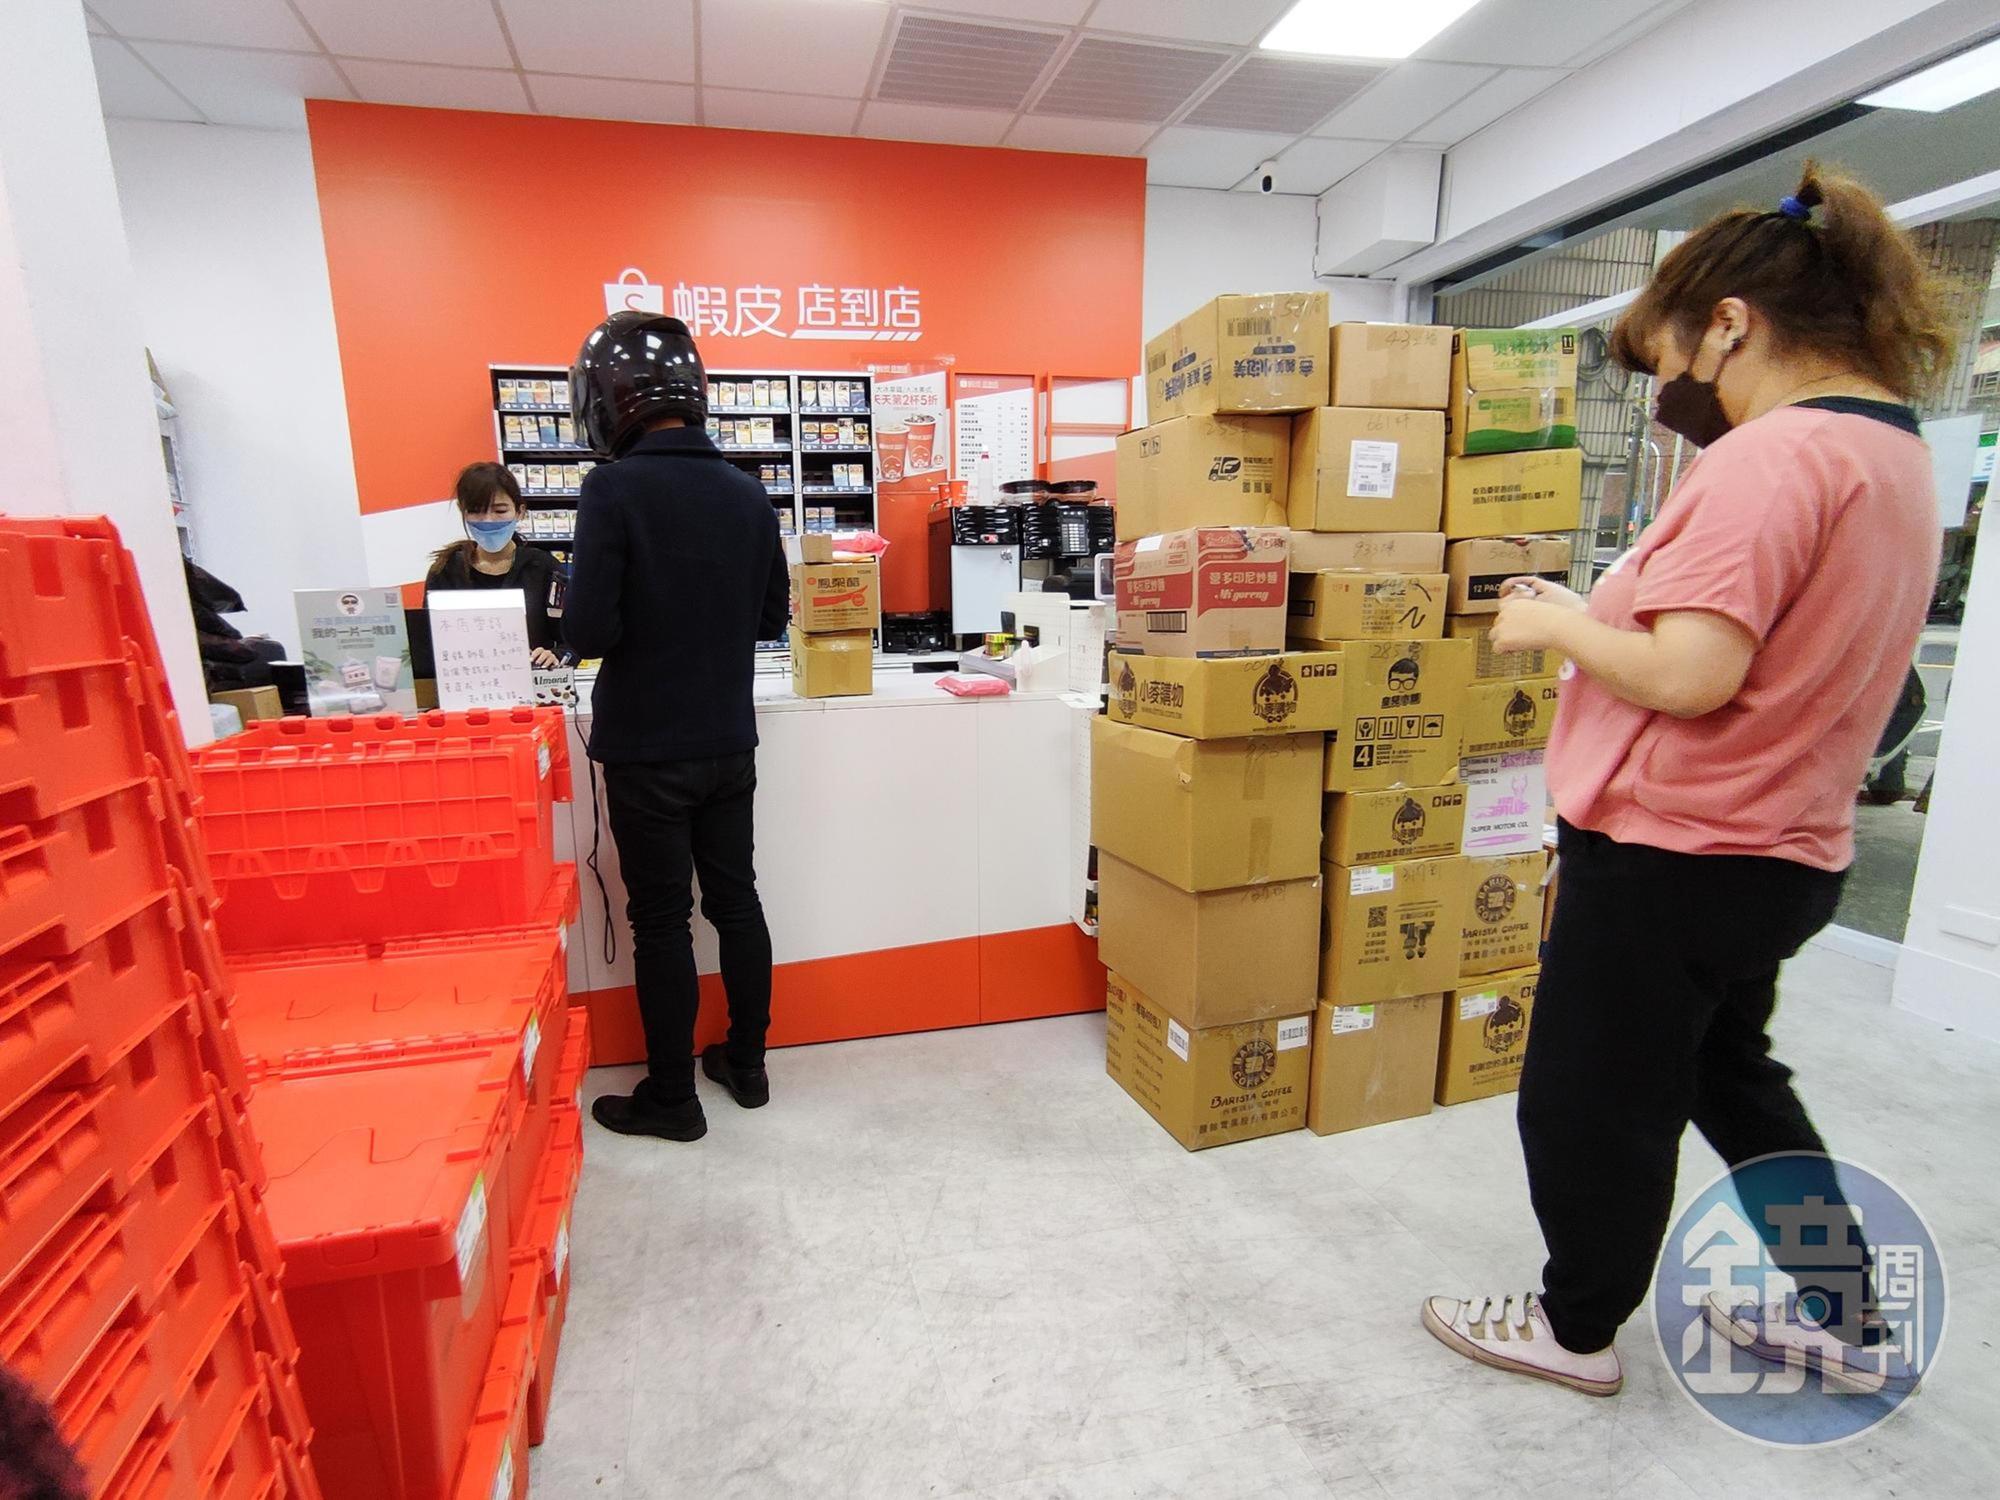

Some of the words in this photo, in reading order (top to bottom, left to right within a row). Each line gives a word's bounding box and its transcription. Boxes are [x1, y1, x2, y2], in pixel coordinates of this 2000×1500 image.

[672, 282, 787, 338] 蝦皮
[797, 284, 923, 329] 店到店
[1356, 745, 1370, 766] 4
[1210, 1092, 1257, 1109] BARISTA
[1261, 1085, 1292, 1099] COFFEE
